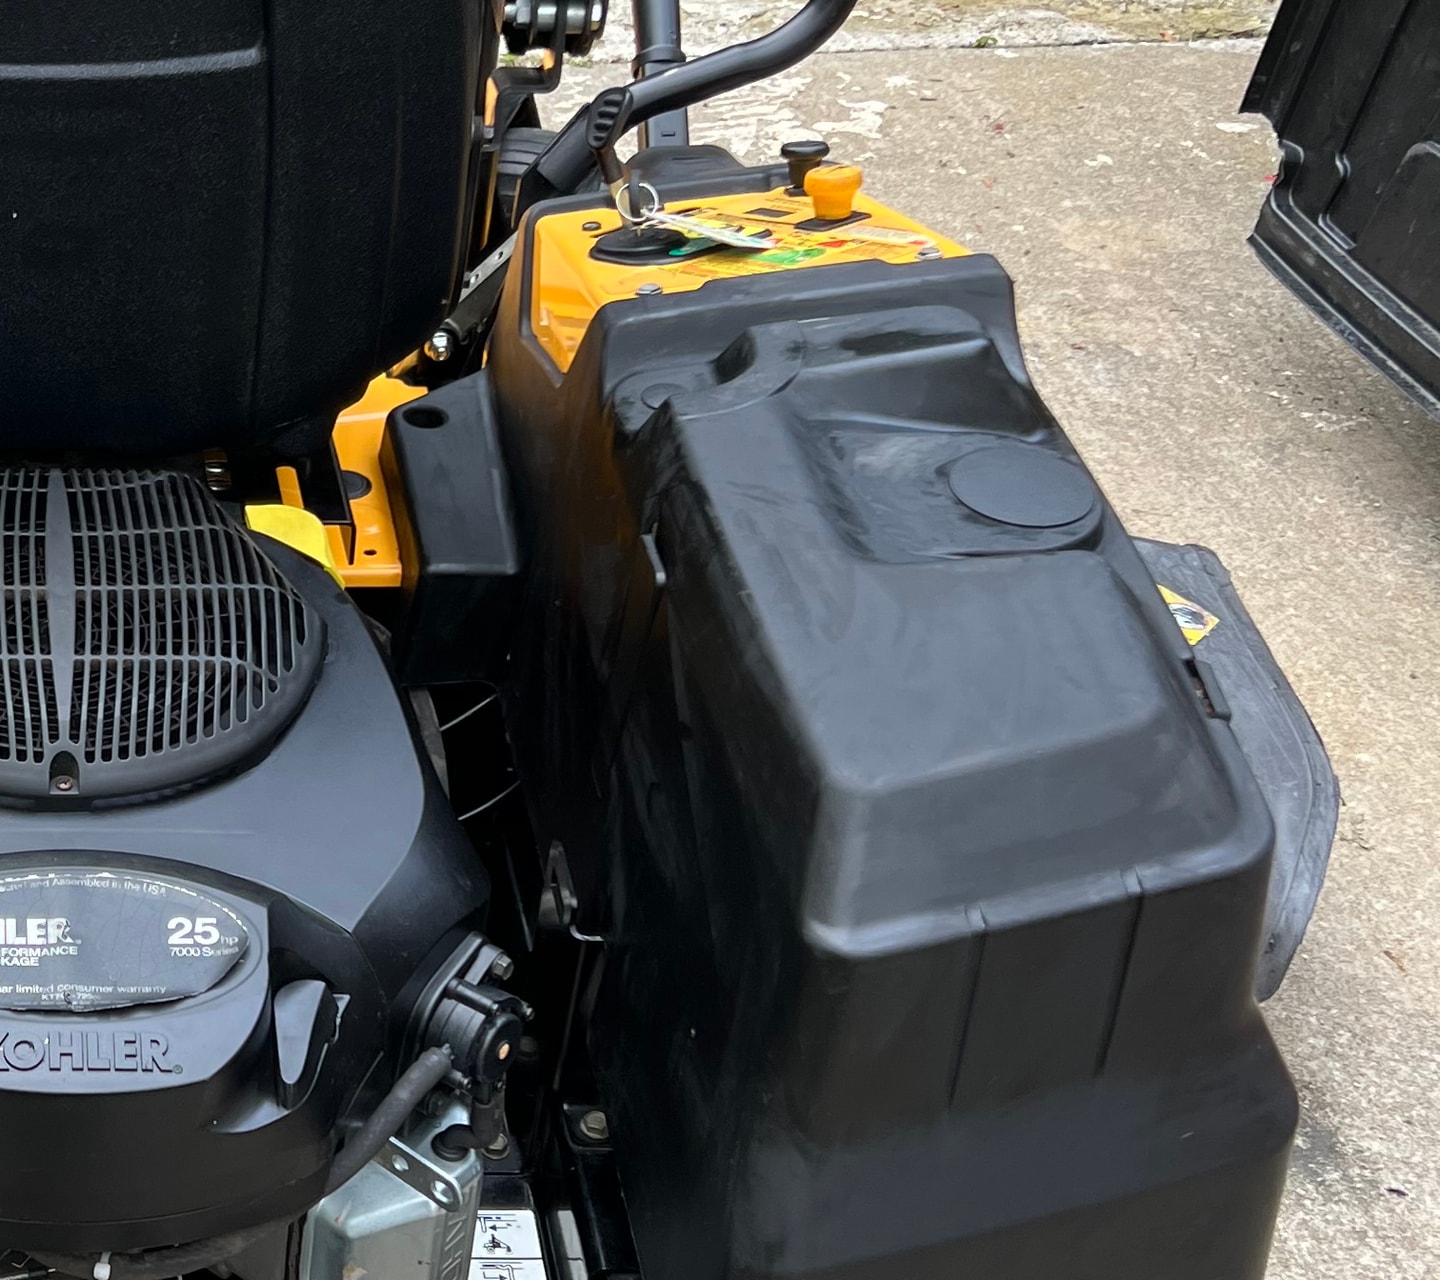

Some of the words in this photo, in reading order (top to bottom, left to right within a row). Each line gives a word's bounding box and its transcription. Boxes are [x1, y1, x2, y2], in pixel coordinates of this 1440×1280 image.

[167, 916, 221, 945] 25
[221, 935, 239, 946] hp
[169, 946, 201, 957] 7000
[202, 945, 239, 957] Series
[15, 983, 54, 994] limited
[56, 983, 114, 994] consumer
[117, 984, 167, 995] warranty
